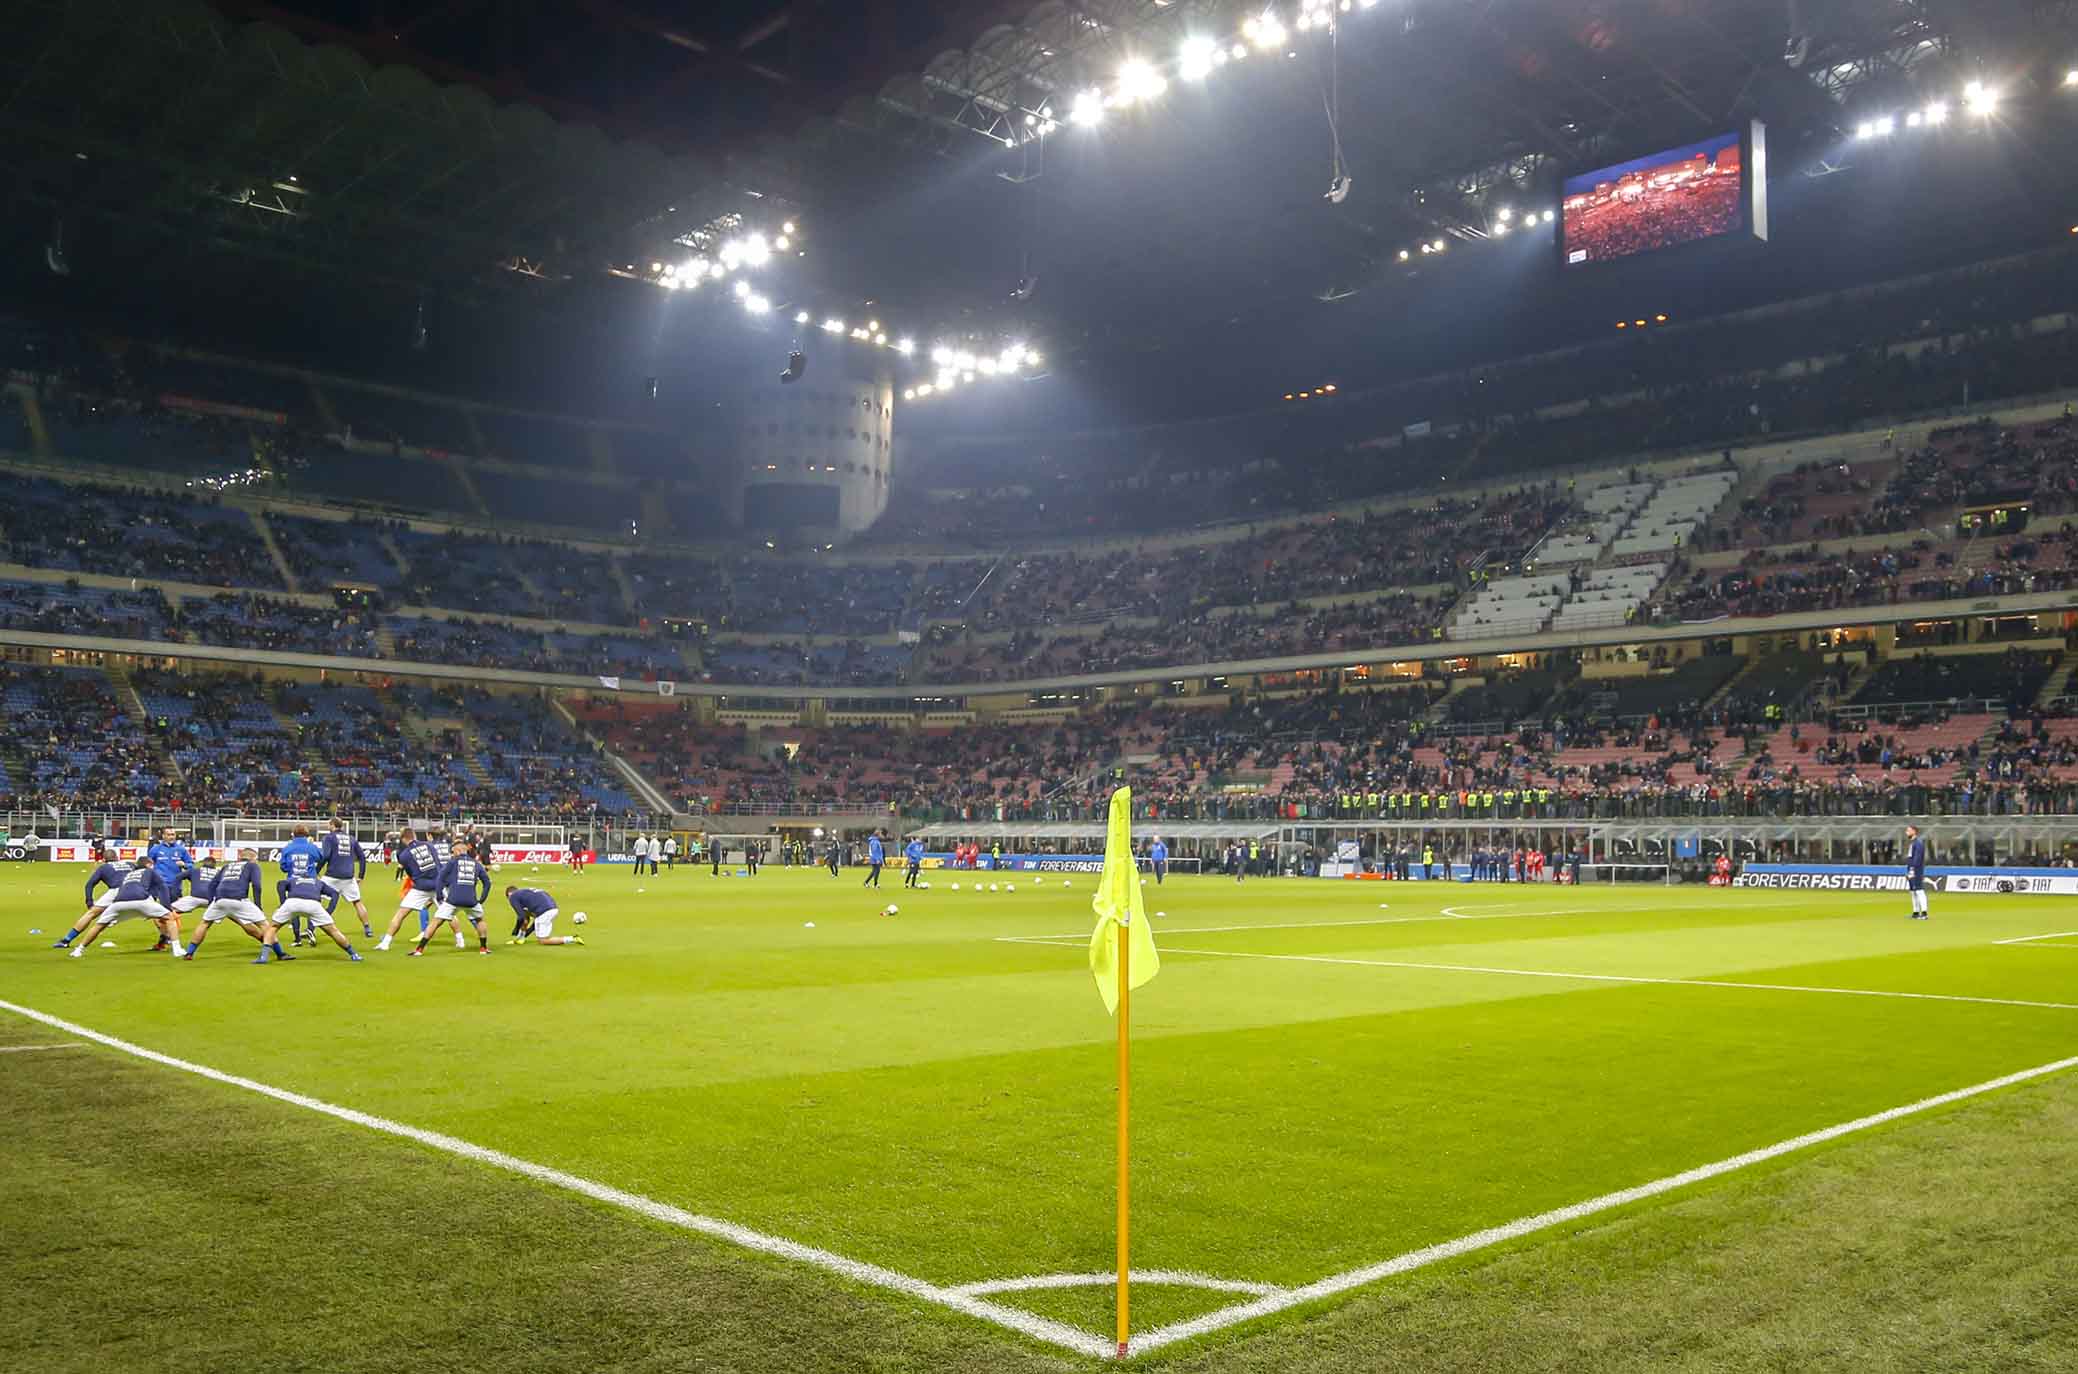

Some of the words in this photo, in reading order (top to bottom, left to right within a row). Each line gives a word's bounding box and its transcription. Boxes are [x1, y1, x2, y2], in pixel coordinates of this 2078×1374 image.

[1039, 861, 1077, 872] FOREVER
[1077, 861, 1105, 872] FASTE
[1741, 873, 1810, 888] FOREVER
[1810, 874, 1874, 889] FASTER.
[1973, 877, 1992, 890] FIAT
[2032, 878, 2053, 891] FIAT
